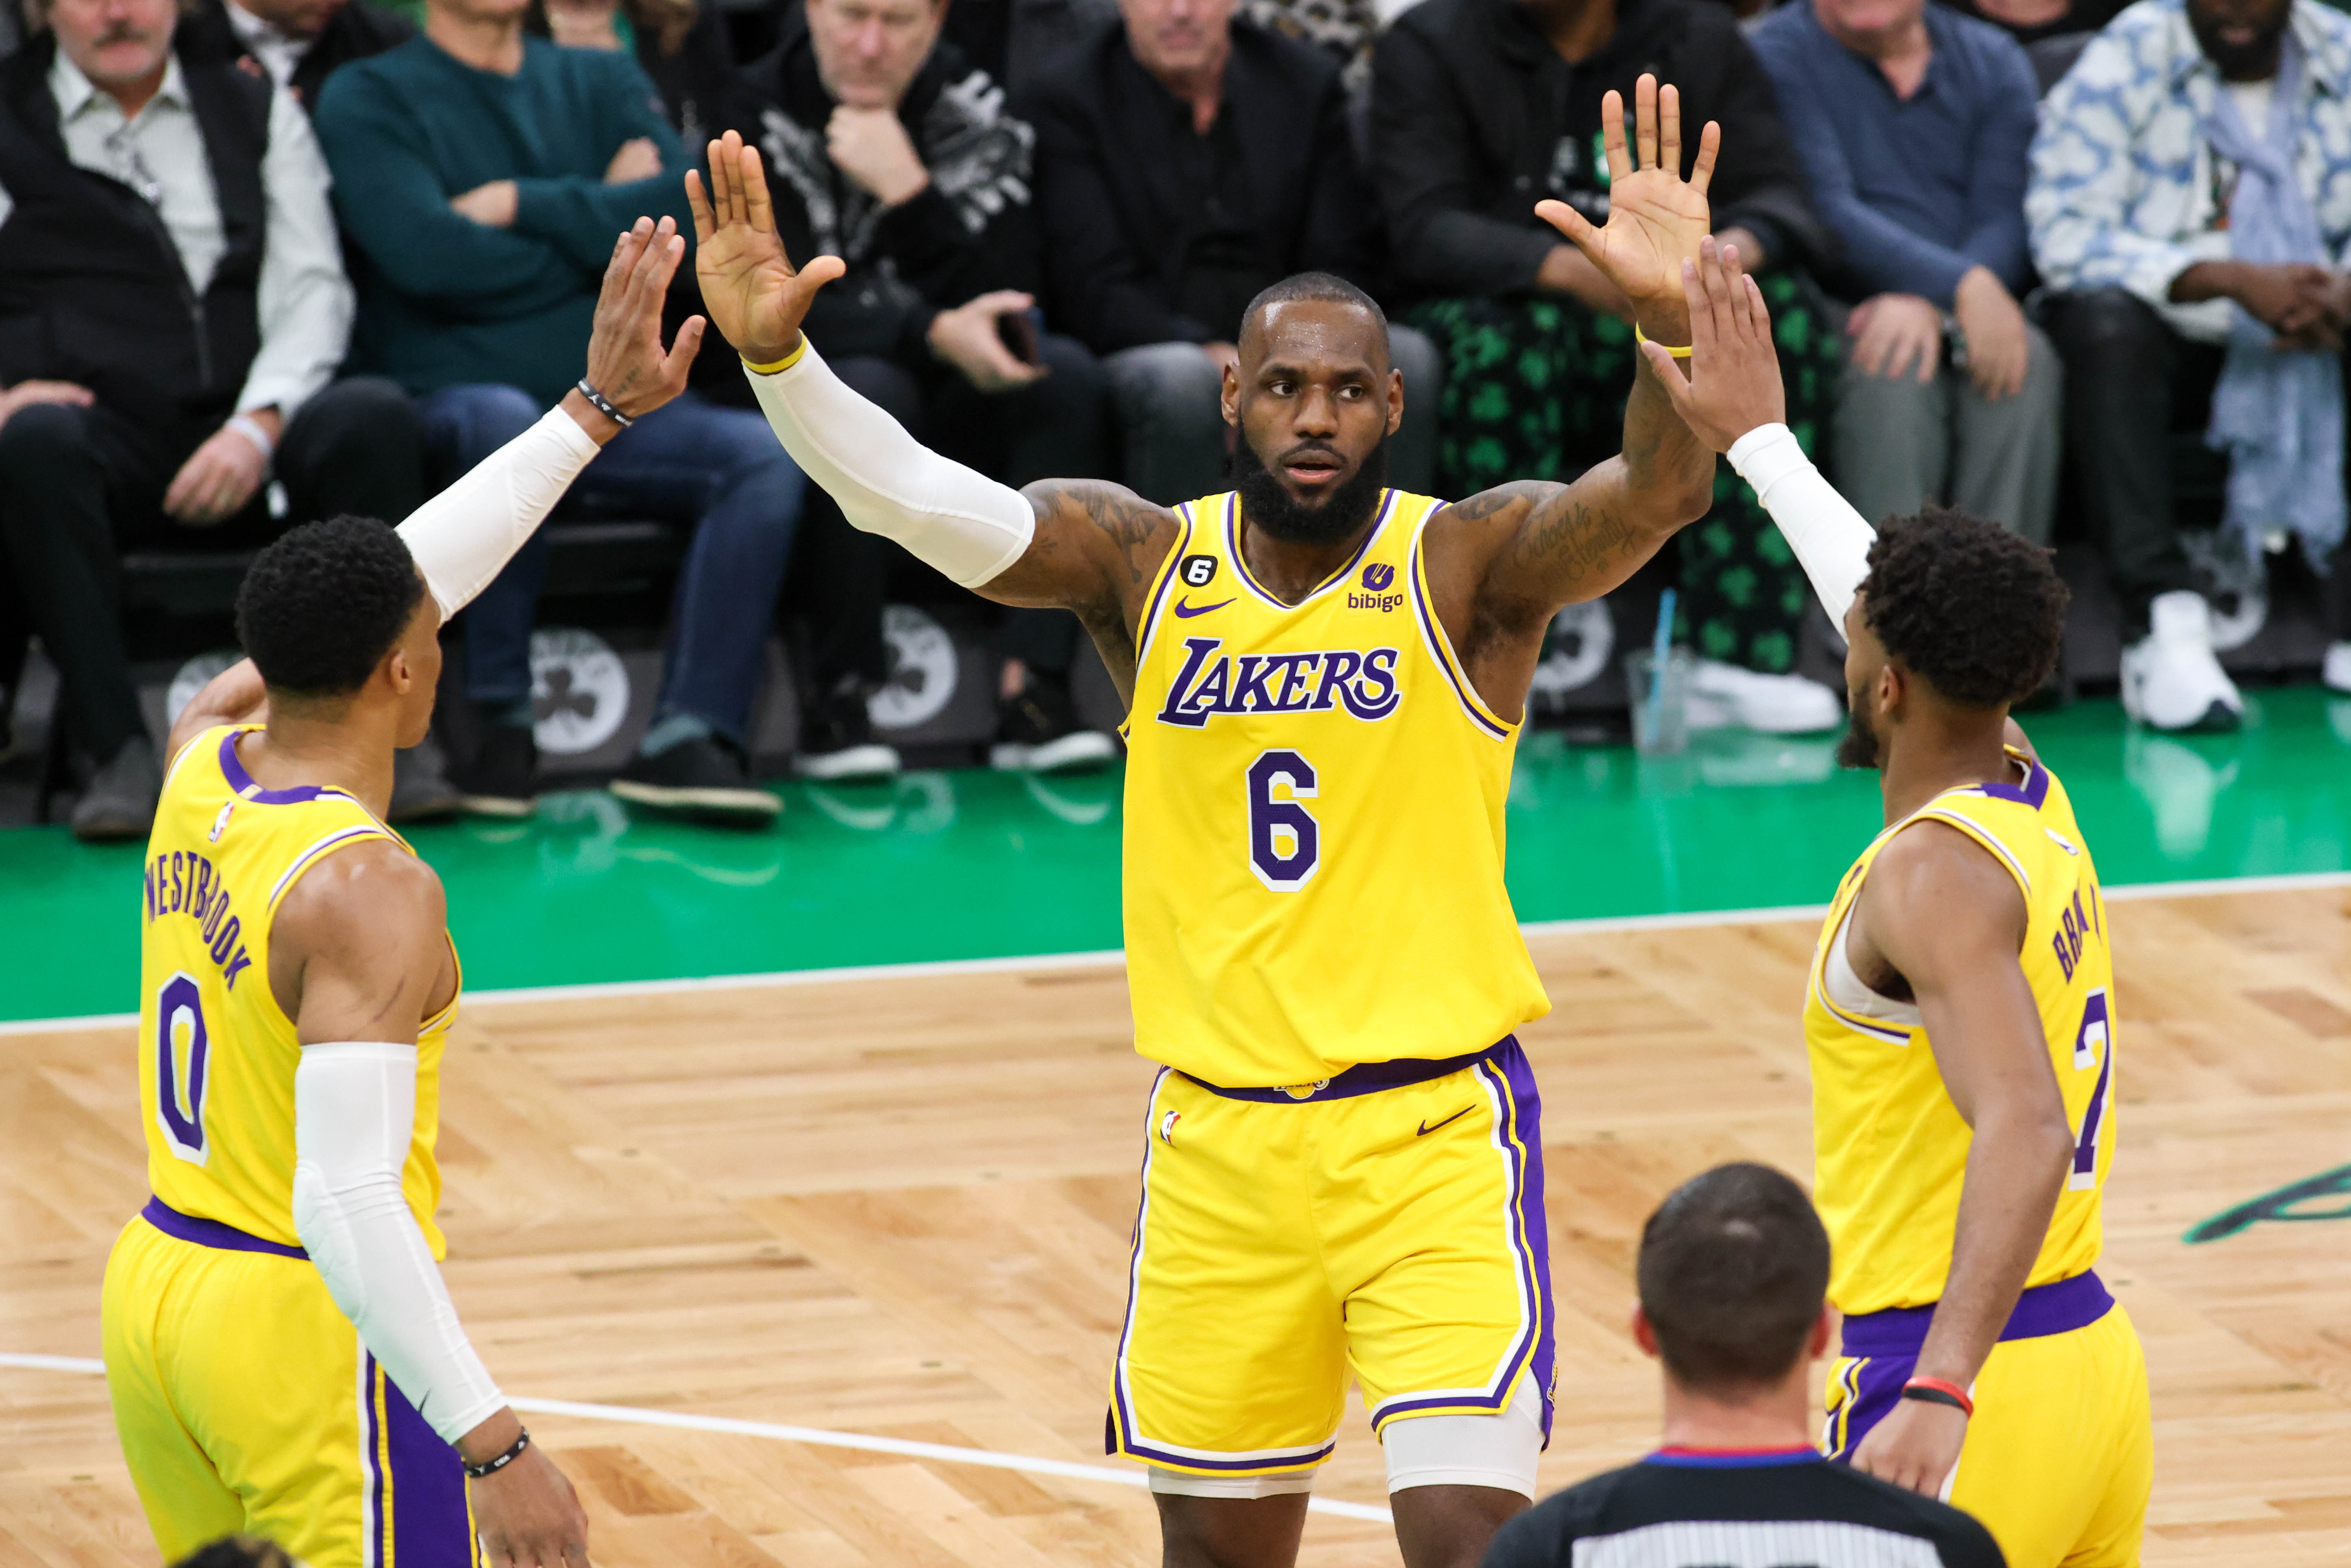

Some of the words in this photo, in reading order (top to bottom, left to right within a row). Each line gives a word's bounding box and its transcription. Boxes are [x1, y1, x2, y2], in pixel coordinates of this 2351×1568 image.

[1187, 559, 1212, 583] 6
[1348, 592, 1403, 613] bibigo
[1155, 635, 1403, 729] LAKERS
[1244, 748, 1320, 893] 6
[155, 969, 211, 1168] 0
[2068, 985, 2112, 1191] 7
